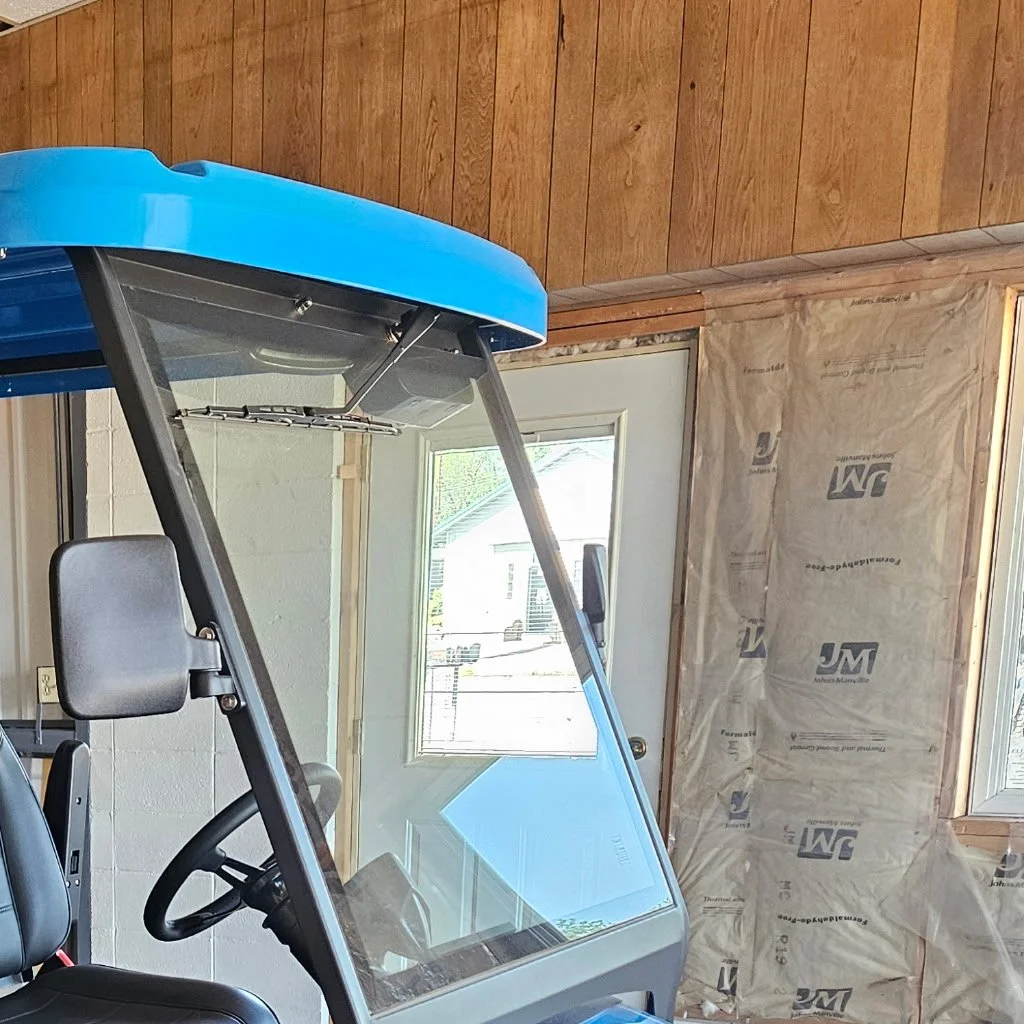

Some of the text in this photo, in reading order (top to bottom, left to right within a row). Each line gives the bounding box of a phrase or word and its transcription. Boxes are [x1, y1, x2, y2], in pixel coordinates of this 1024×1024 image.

[827, 462, 892, 500] JM
[805, 557, 901, 572] Formaldehyde-Free
[816, 642, 879, 675] JM
[797, 827, 859, 860] JM
[777, 914, 868, 925] Formaldehyde-Free
[792, 987, 853, 1012] JM
